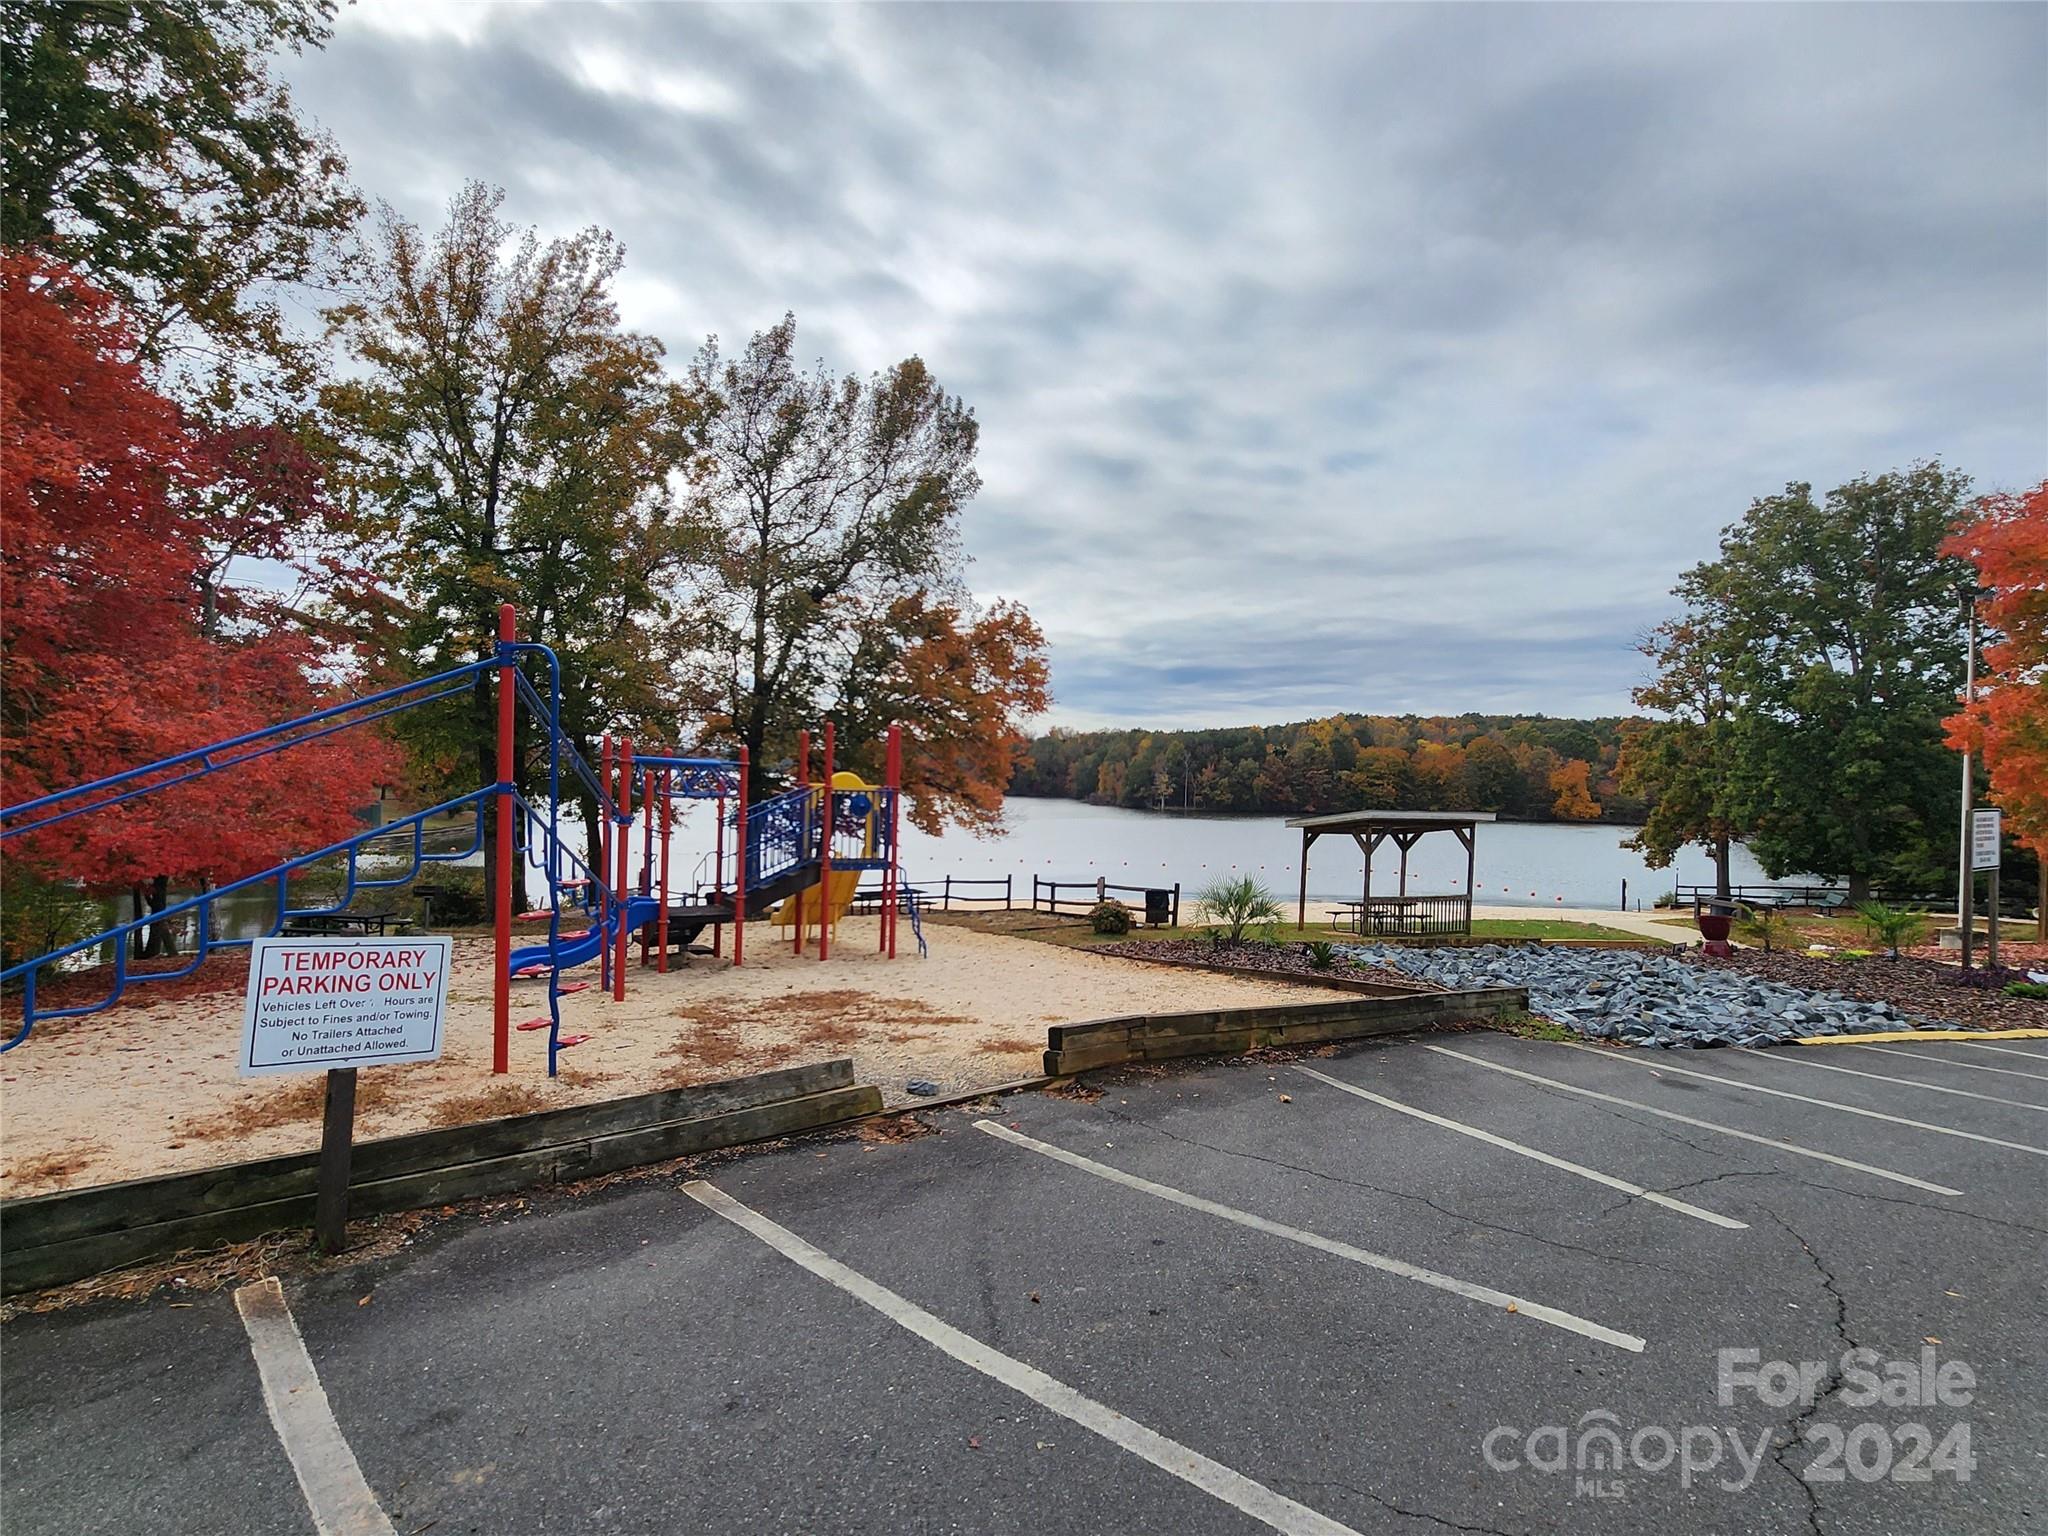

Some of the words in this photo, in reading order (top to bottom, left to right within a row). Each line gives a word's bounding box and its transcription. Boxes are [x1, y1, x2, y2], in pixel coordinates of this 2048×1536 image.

[281, 950, 427, 971] TEMPORARY
[263, 974, 371, 996] PARKING
[379, 971, 437, 991] ONLY
[262, 1002, 311, 1012] Vehicles
[315, 1000, 336, 1010] Left
[384, 997, 415, 1006] Hours
[418, 996, 433, 1004] are
[260, 1018, 305, 1029] Subject
[308, 1016, 319, 1025] to
[323, 1014, 353, 1024] Fines
[356, 1012, 390, 1022] and/or
[394, 1010, 432, 1022] Towing.
[292, 1031, 308, 1041] No
[313, 1029, 352, 1040] Trailers
[356, 1025, 403, 1037] Attached
[281, 1048, 293, 1057] or
[297, 1043, 361, 1056] Unattached
[364, 1039, 409, 1051] Allowed.
